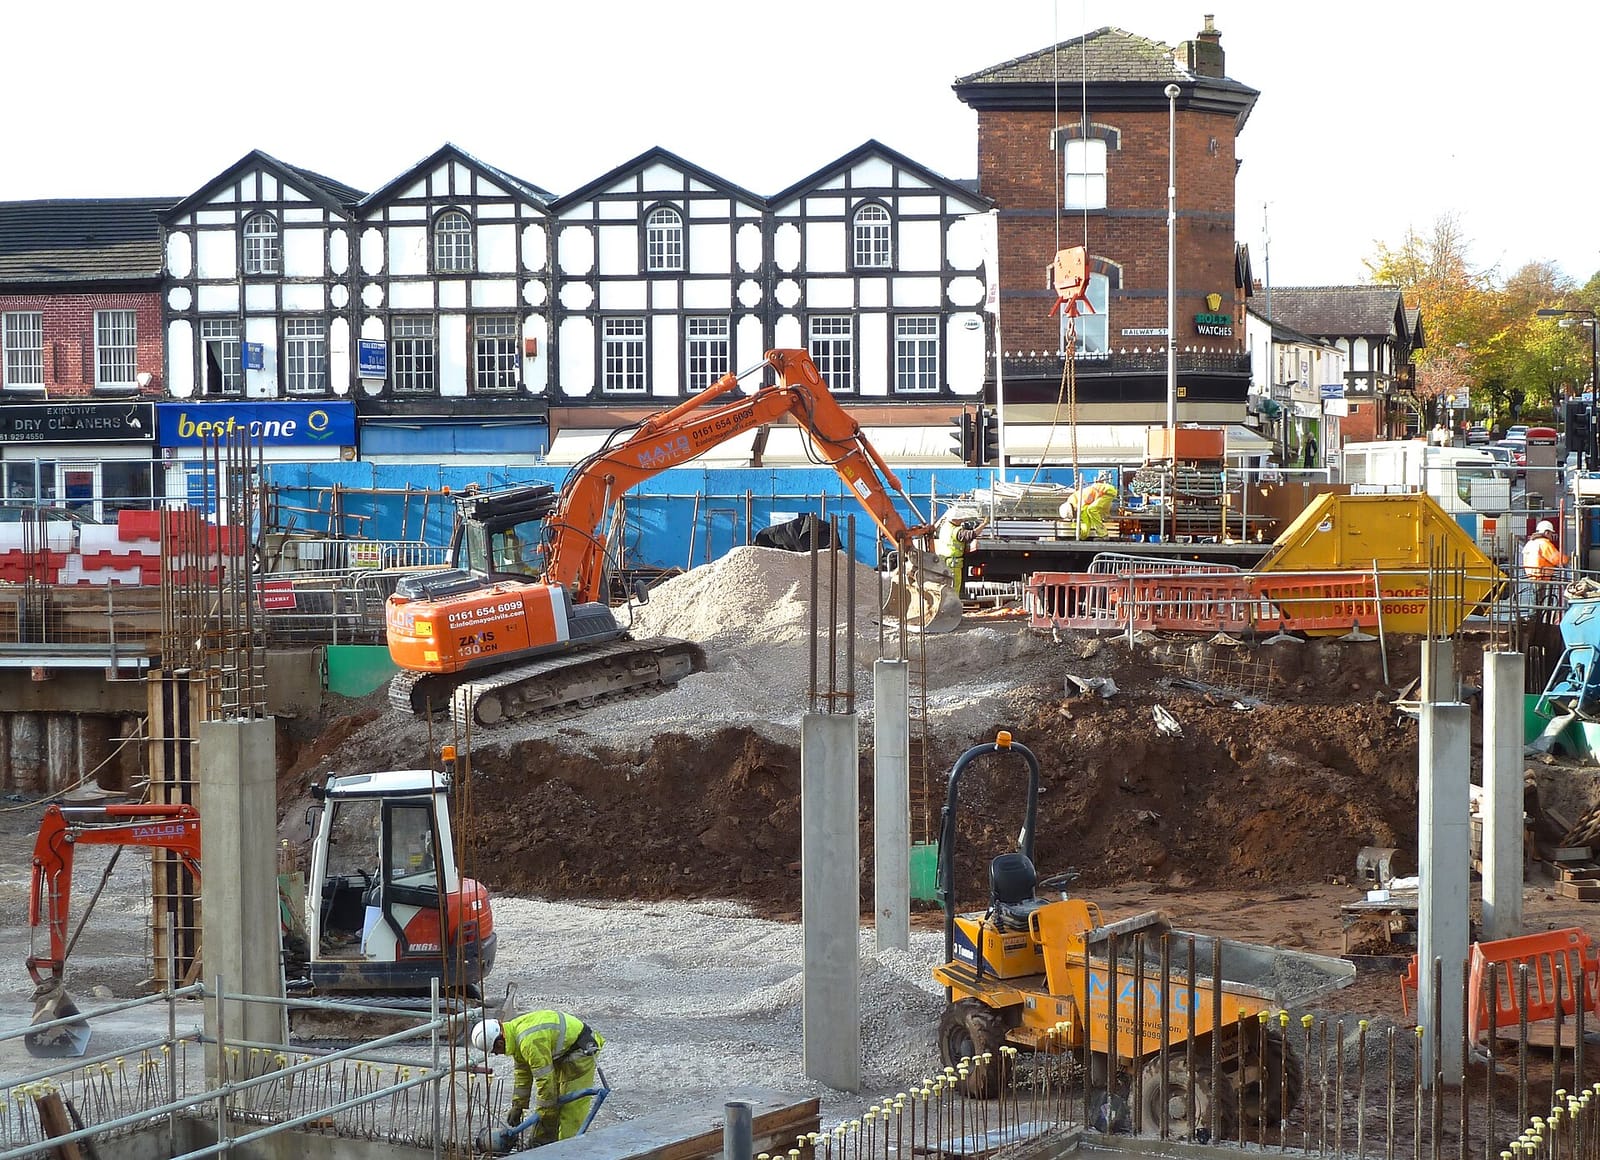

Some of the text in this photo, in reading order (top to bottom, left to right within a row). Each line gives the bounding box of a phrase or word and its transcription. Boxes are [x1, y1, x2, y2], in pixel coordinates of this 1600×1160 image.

[1196, 313, 1232, 325] ROLEX
[1197, 325, 1232, 336] WATCHES
[47, 407, 97, 415] EXECUTIVE
[15, 417, 121, 430] DRY CLANERS
[178, 413, 297, 438] best-one
[692, 425, 713, 439] 0161
[715, 417, 732, 430] 654
[638, 435, 689, 463] MAYO
[448, 600, 523, 622] 0161 654 6099
[459, 631, 495, 646] ZAXIS
[132, 825, 185, 835] TAYLOR
